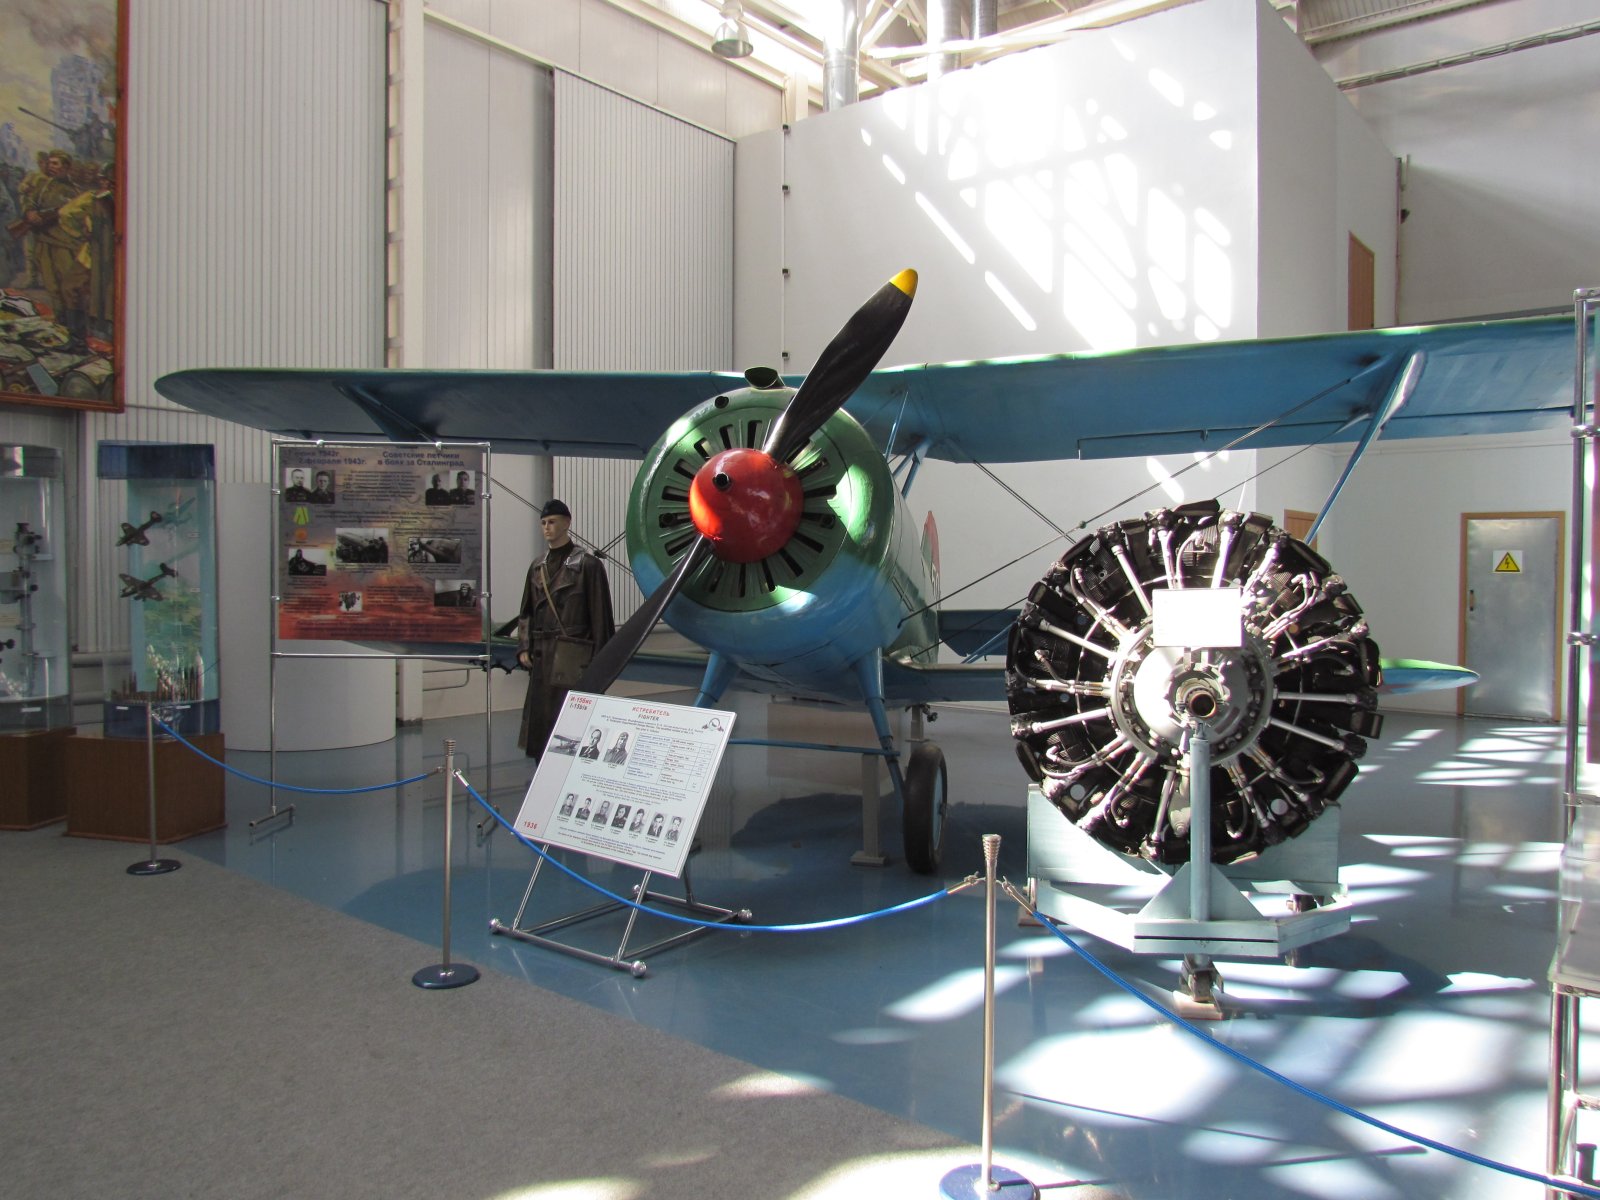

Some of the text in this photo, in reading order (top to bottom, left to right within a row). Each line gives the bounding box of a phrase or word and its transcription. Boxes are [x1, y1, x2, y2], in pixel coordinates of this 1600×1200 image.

[382, 450, 425, 458] Советские
[416, 458, 465, 467] Сталинград
[632, 707, 670, 716] ИСТРЕБИТЕЛЬ
